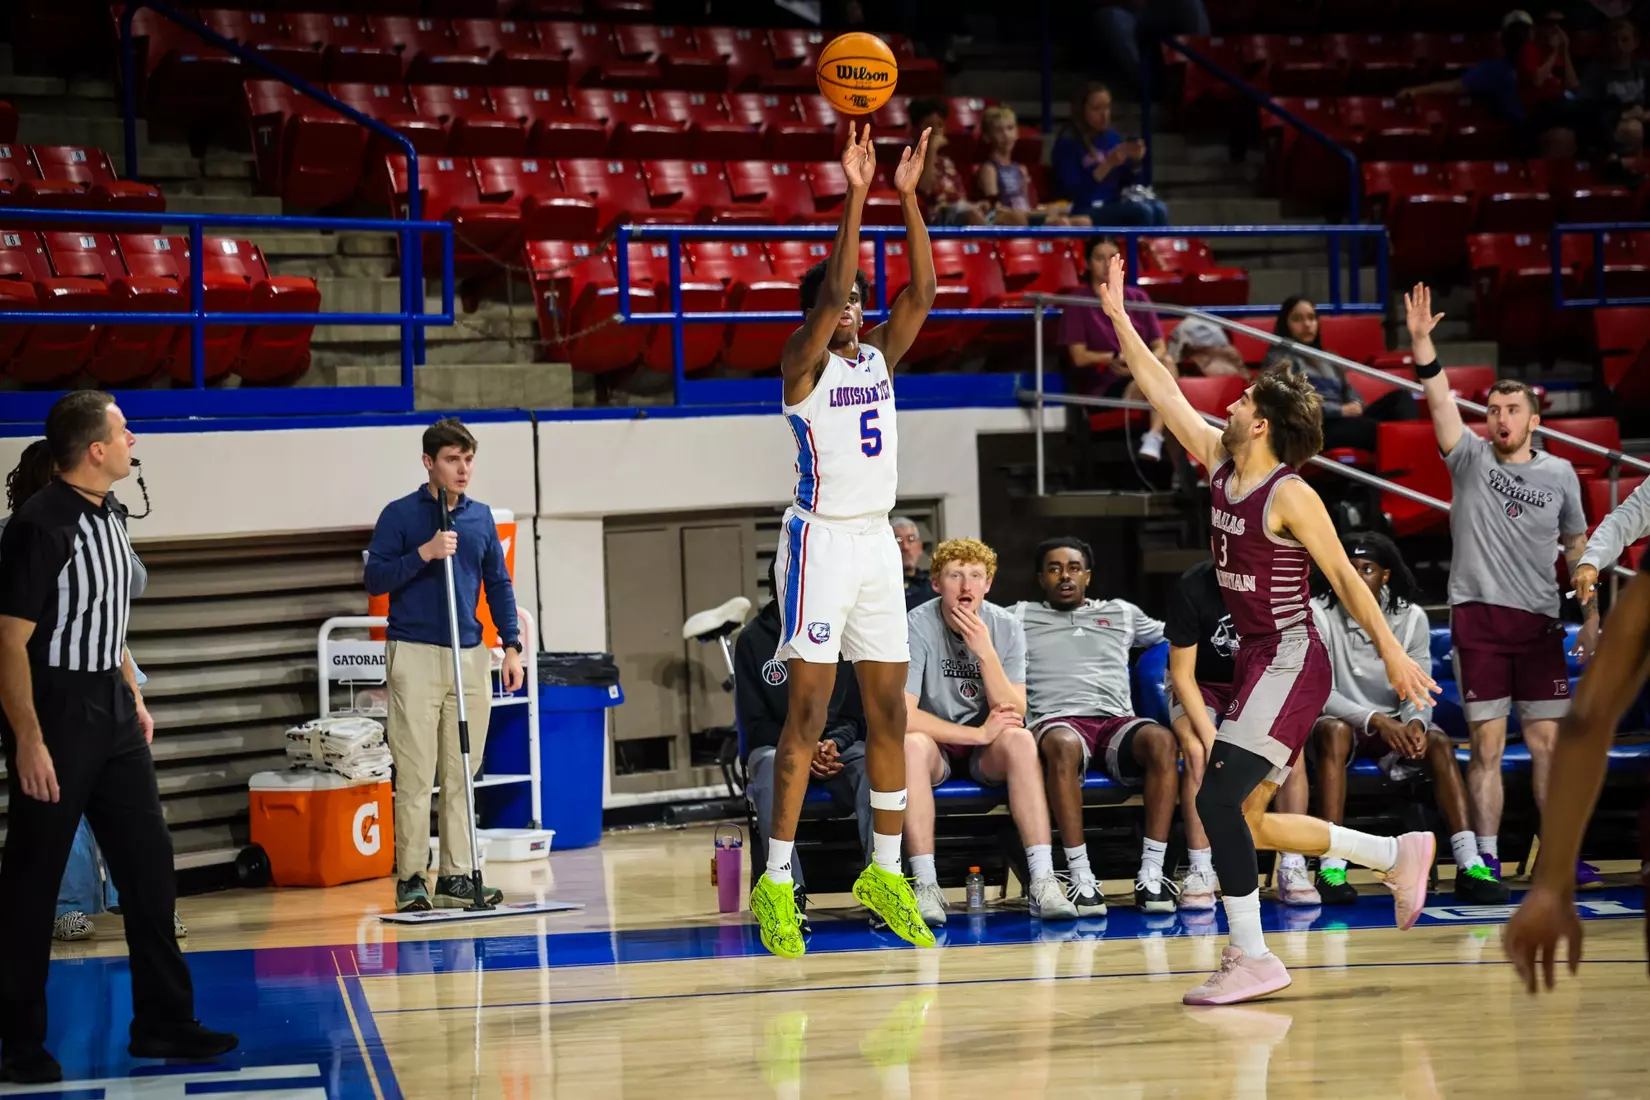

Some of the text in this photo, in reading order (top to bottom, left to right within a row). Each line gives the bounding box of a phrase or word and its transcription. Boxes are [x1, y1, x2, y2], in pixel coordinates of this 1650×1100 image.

[836, 65, 889, 82] Wilson
[859, 408, 882, 457] 5
[332, 654, 387, 666] GATORAD
[940, 658, 981, 673] CRUSADE
[352, 800, 381, 857] G
